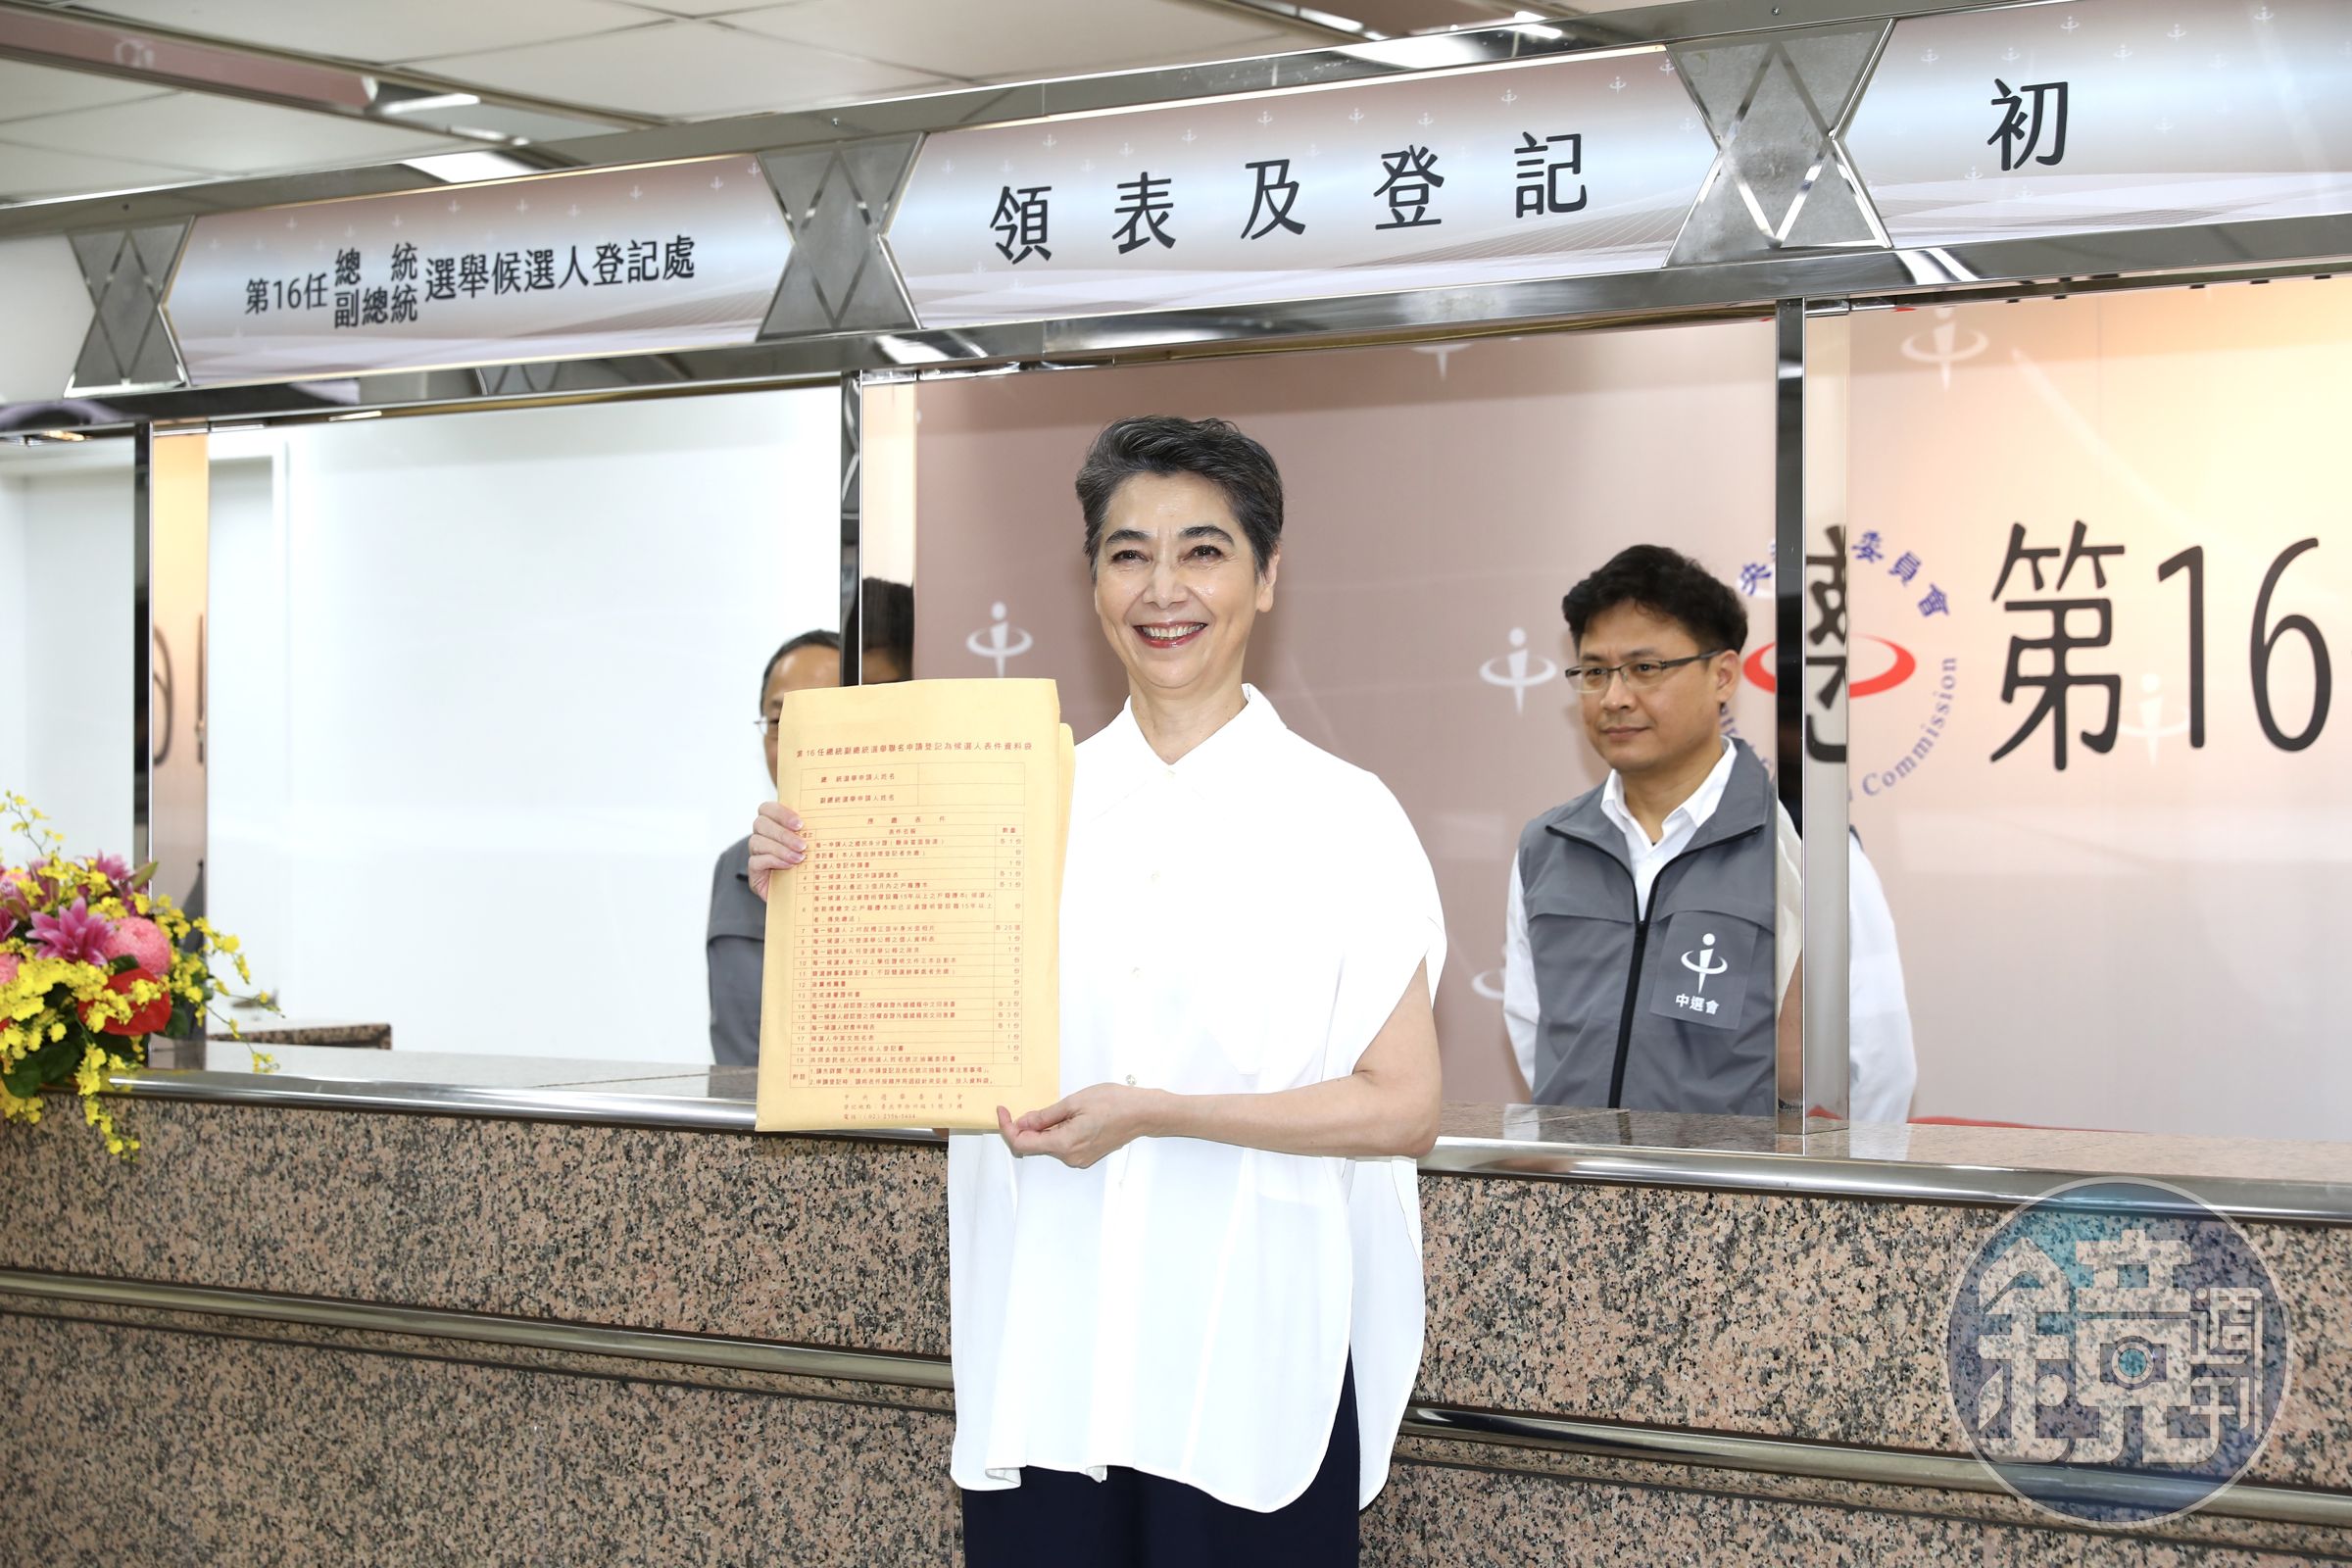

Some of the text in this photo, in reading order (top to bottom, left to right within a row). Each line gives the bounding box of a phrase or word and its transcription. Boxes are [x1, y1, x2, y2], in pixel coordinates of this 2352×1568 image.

[1986, 77, 2069, 172] 初
[989, 130, 1588, 266] 領表及登記
[244, 271, 328, 316] 第16任
[334, 283, 418, 329] 副總統
[424, 234, 695, 303] 選舉候選人登記處
[1989, 518, 2332, 771] 第16
[1862, 657, 1957, 797] Commission
[1675, 993, 1720, 1015] 中選會
